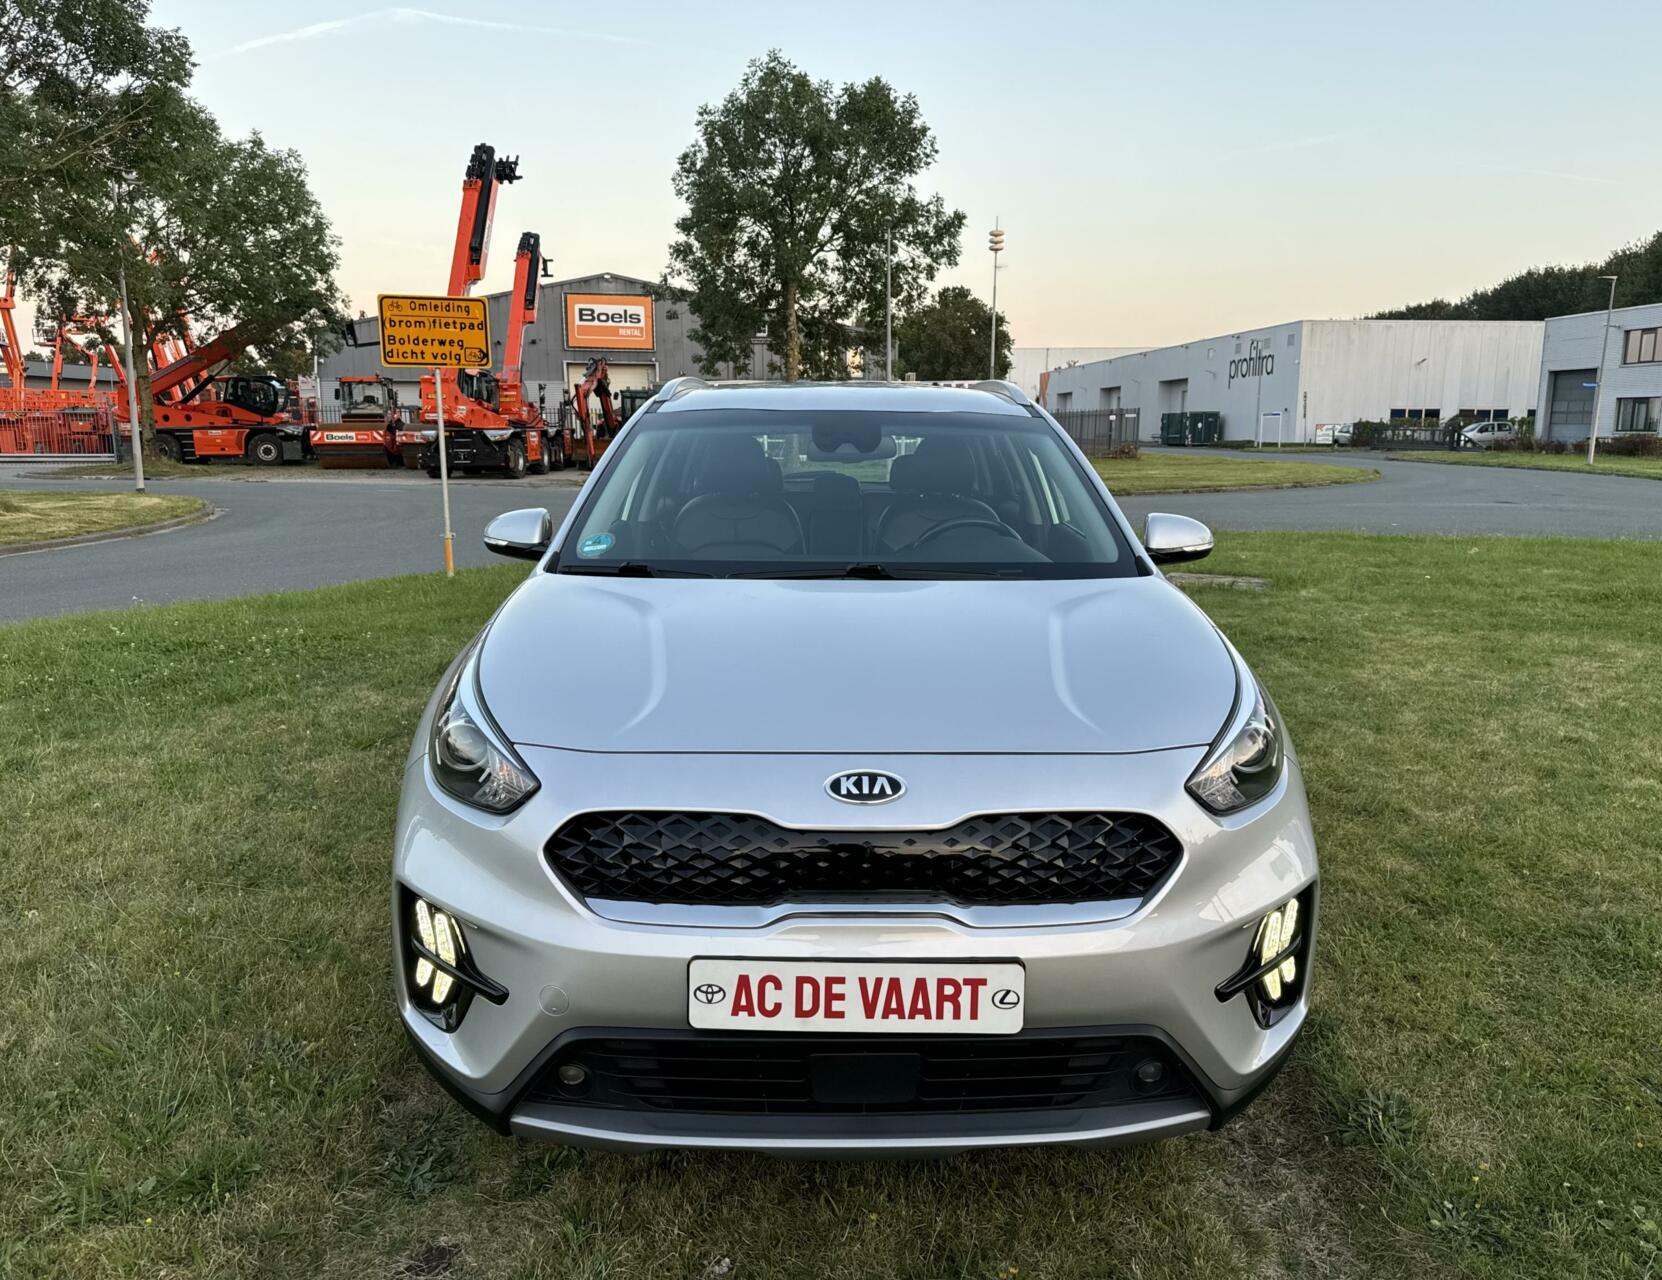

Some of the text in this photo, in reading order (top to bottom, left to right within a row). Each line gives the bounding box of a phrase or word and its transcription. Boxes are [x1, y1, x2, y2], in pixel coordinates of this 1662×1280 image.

[408, 300, 471, 316] Omleiding
[578, 307, 642, 324] Boels
[383, 317, 484, 331] (brom)fietpad
[618, 328, 642, 336] RENTAL
[387, 335, 464, 350] Bolderweg
[386, 348, 461, 364] dicht volg
[1228, 338, 1275, 390] profiltra
[325, 433, 354, 441] Boels
[840, 775, 893, 795] KIA
[731, 974, 988, 1020] AC DE VAART
